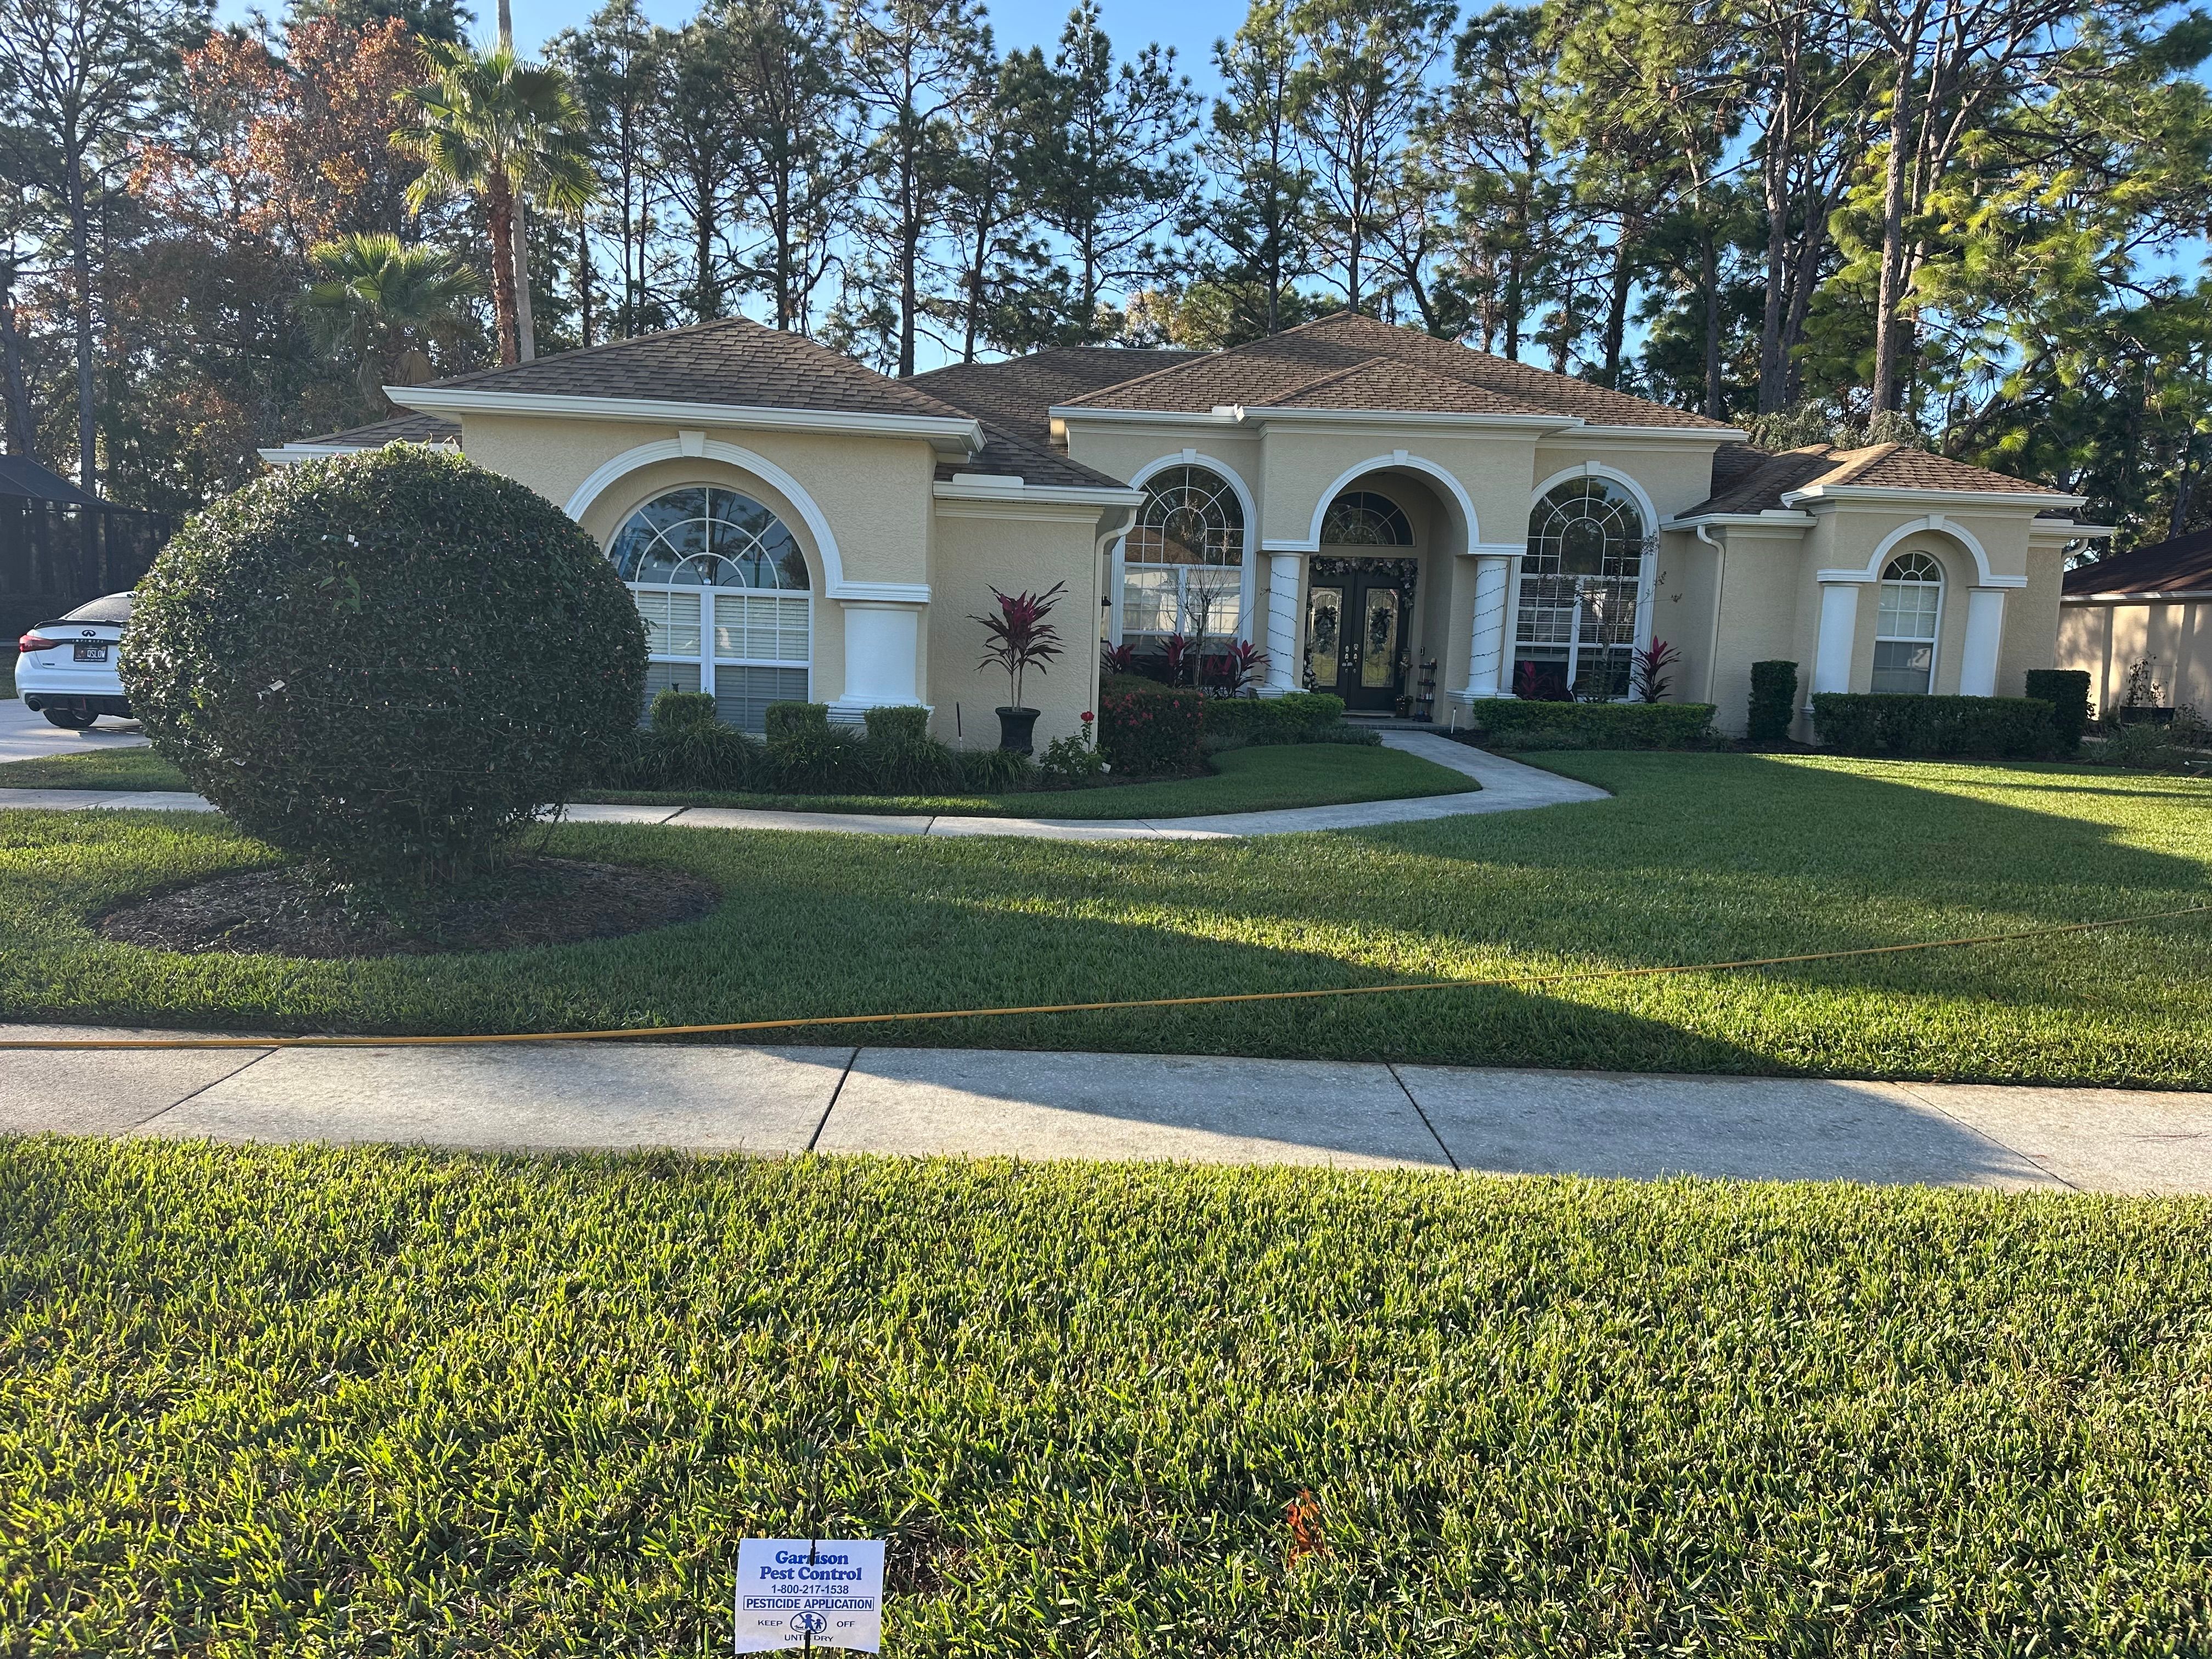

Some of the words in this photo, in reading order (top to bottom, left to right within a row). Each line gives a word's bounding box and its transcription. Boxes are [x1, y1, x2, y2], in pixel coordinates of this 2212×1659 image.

[760, 1566, 794, 1579] Pest
[798, 1567, 862, 1581] Control
[771, 1584, 849, 1594] 1-800-217-1538
[746, 1598, 800, 1609] PESTICIDE
[804, 1599, 872, 1609] APPLICATION
